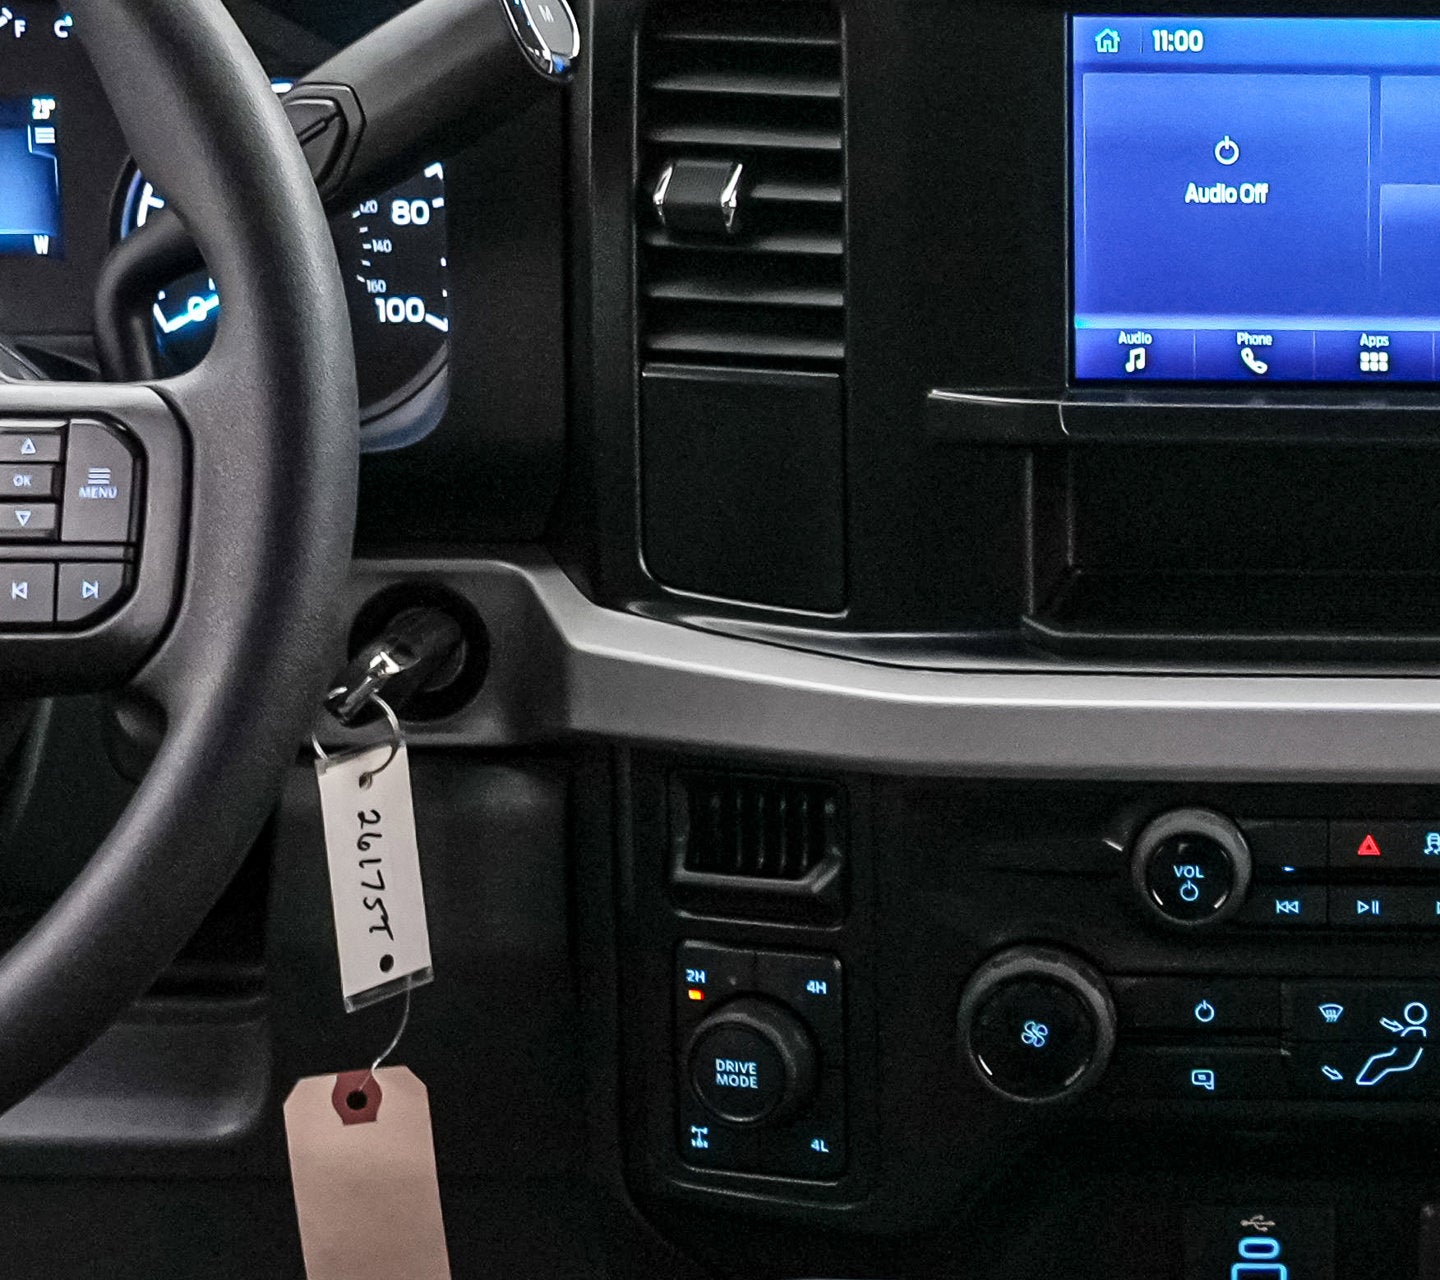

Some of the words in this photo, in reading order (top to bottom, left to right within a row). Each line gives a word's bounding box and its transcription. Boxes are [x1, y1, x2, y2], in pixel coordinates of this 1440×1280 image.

[15, 21, 26, 38] F
[55, 20, 69, 38] C
[1152, 29, 1203, 52] 11:00
[1185, 183, 1236, 205] Audio
[1240, 183, 1269, 205] Off
[392, 200, 430, 225] 80
[34, 235, 49, 255] W
[372, 239, 392, 253] 140
[366, 280, 386, 294] 160
[375, 297, 425, 323] 100
[1118, 332, 1152, 346] Audio
[1236, 333, 1273, 347] Phone
[1360, 334, 1389, 351] Apps
[13, 474, 32, 488] OK
[79, 486, 117, 500] MENU
[1173, 865, 1205, 880] VOL
[685, 970, 706, 984] 2H
[806, 979, 827, 995] 4H
[715, 1060, 758, 1075] DRIVE
[715, 1074, 759, 1090] MODE
[811, 1138, 829, 1153] 4L
